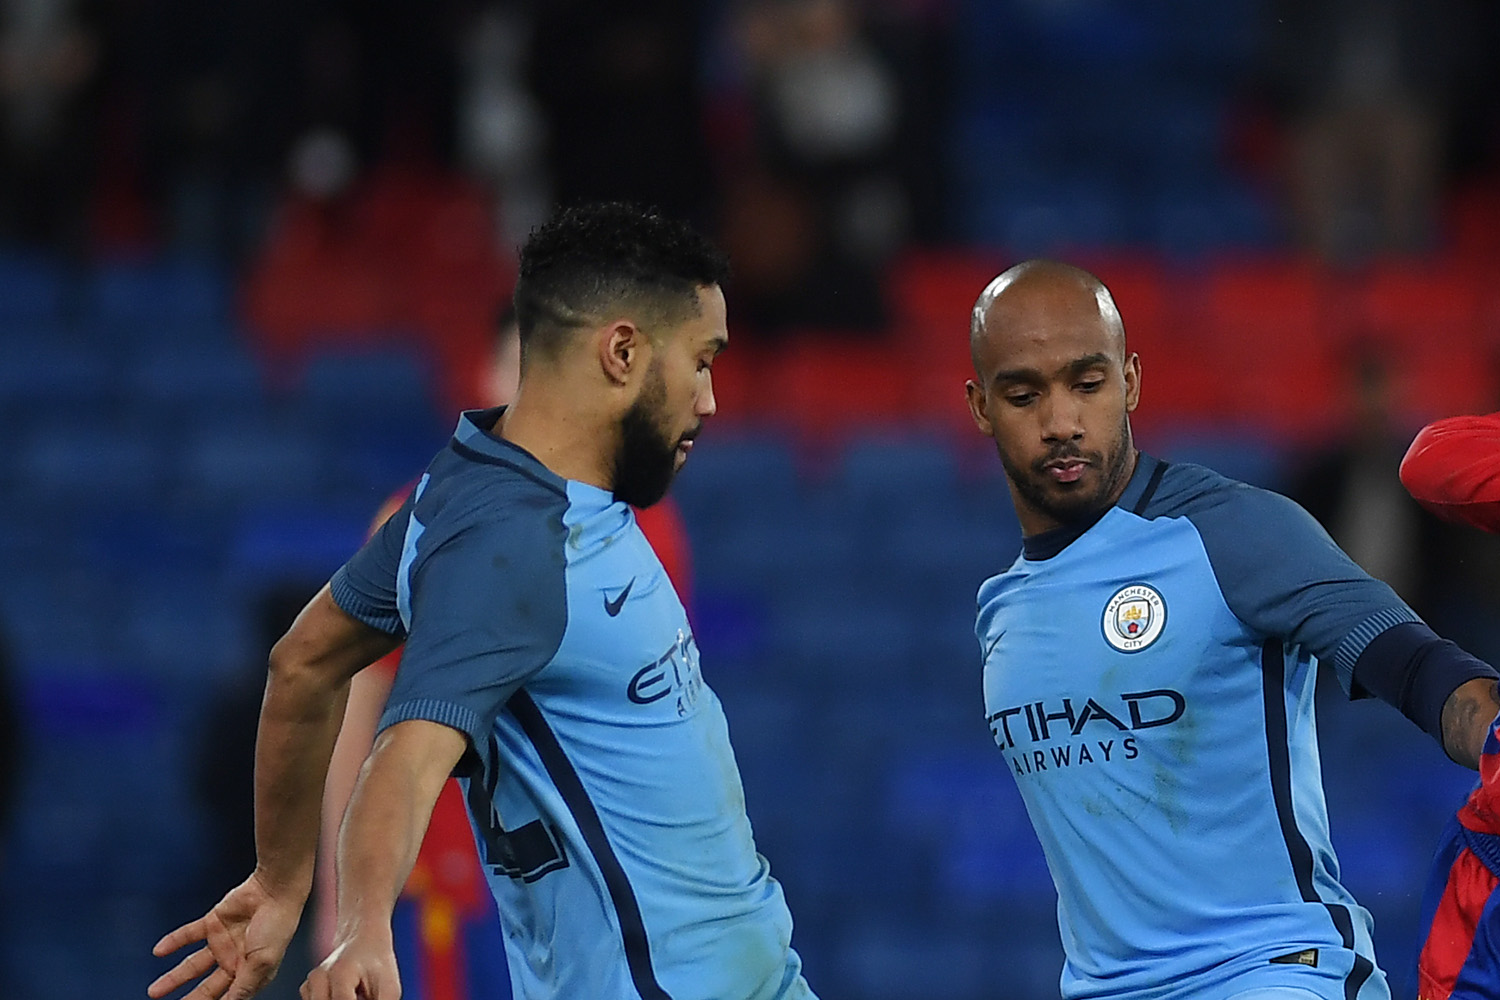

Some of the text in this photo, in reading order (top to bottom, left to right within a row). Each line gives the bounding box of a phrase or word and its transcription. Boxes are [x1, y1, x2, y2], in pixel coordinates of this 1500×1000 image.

[1108, 588, 1160, 613] MANCHESTER
[1123, 640, 1143, 649] CITY
[1012, 738, 1139, 777] AIRWAYS
